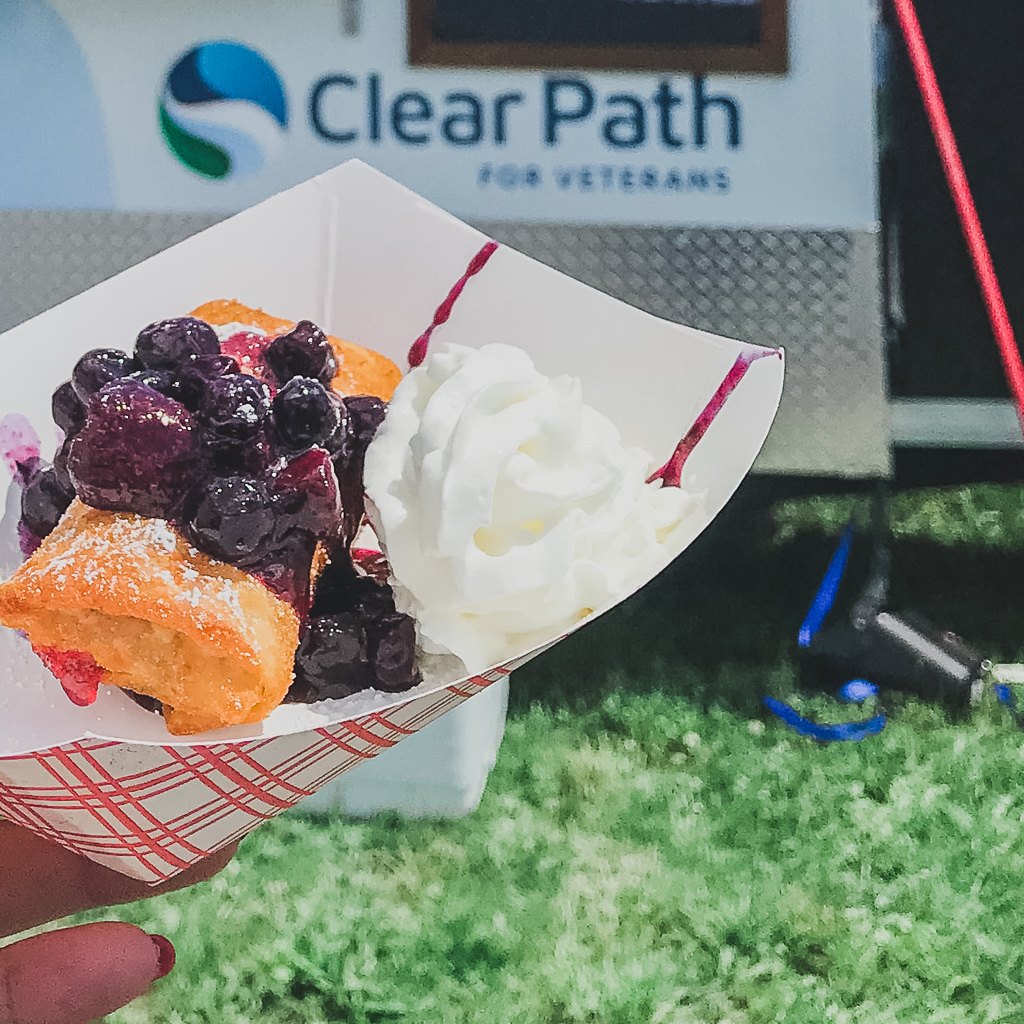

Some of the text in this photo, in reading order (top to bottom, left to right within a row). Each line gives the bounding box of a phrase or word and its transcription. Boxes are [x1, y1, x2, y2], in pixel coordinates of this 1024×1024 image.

[309, 72, 742, 148] Clear Path
[479, 164, 732, 193] FOR VETERANS
